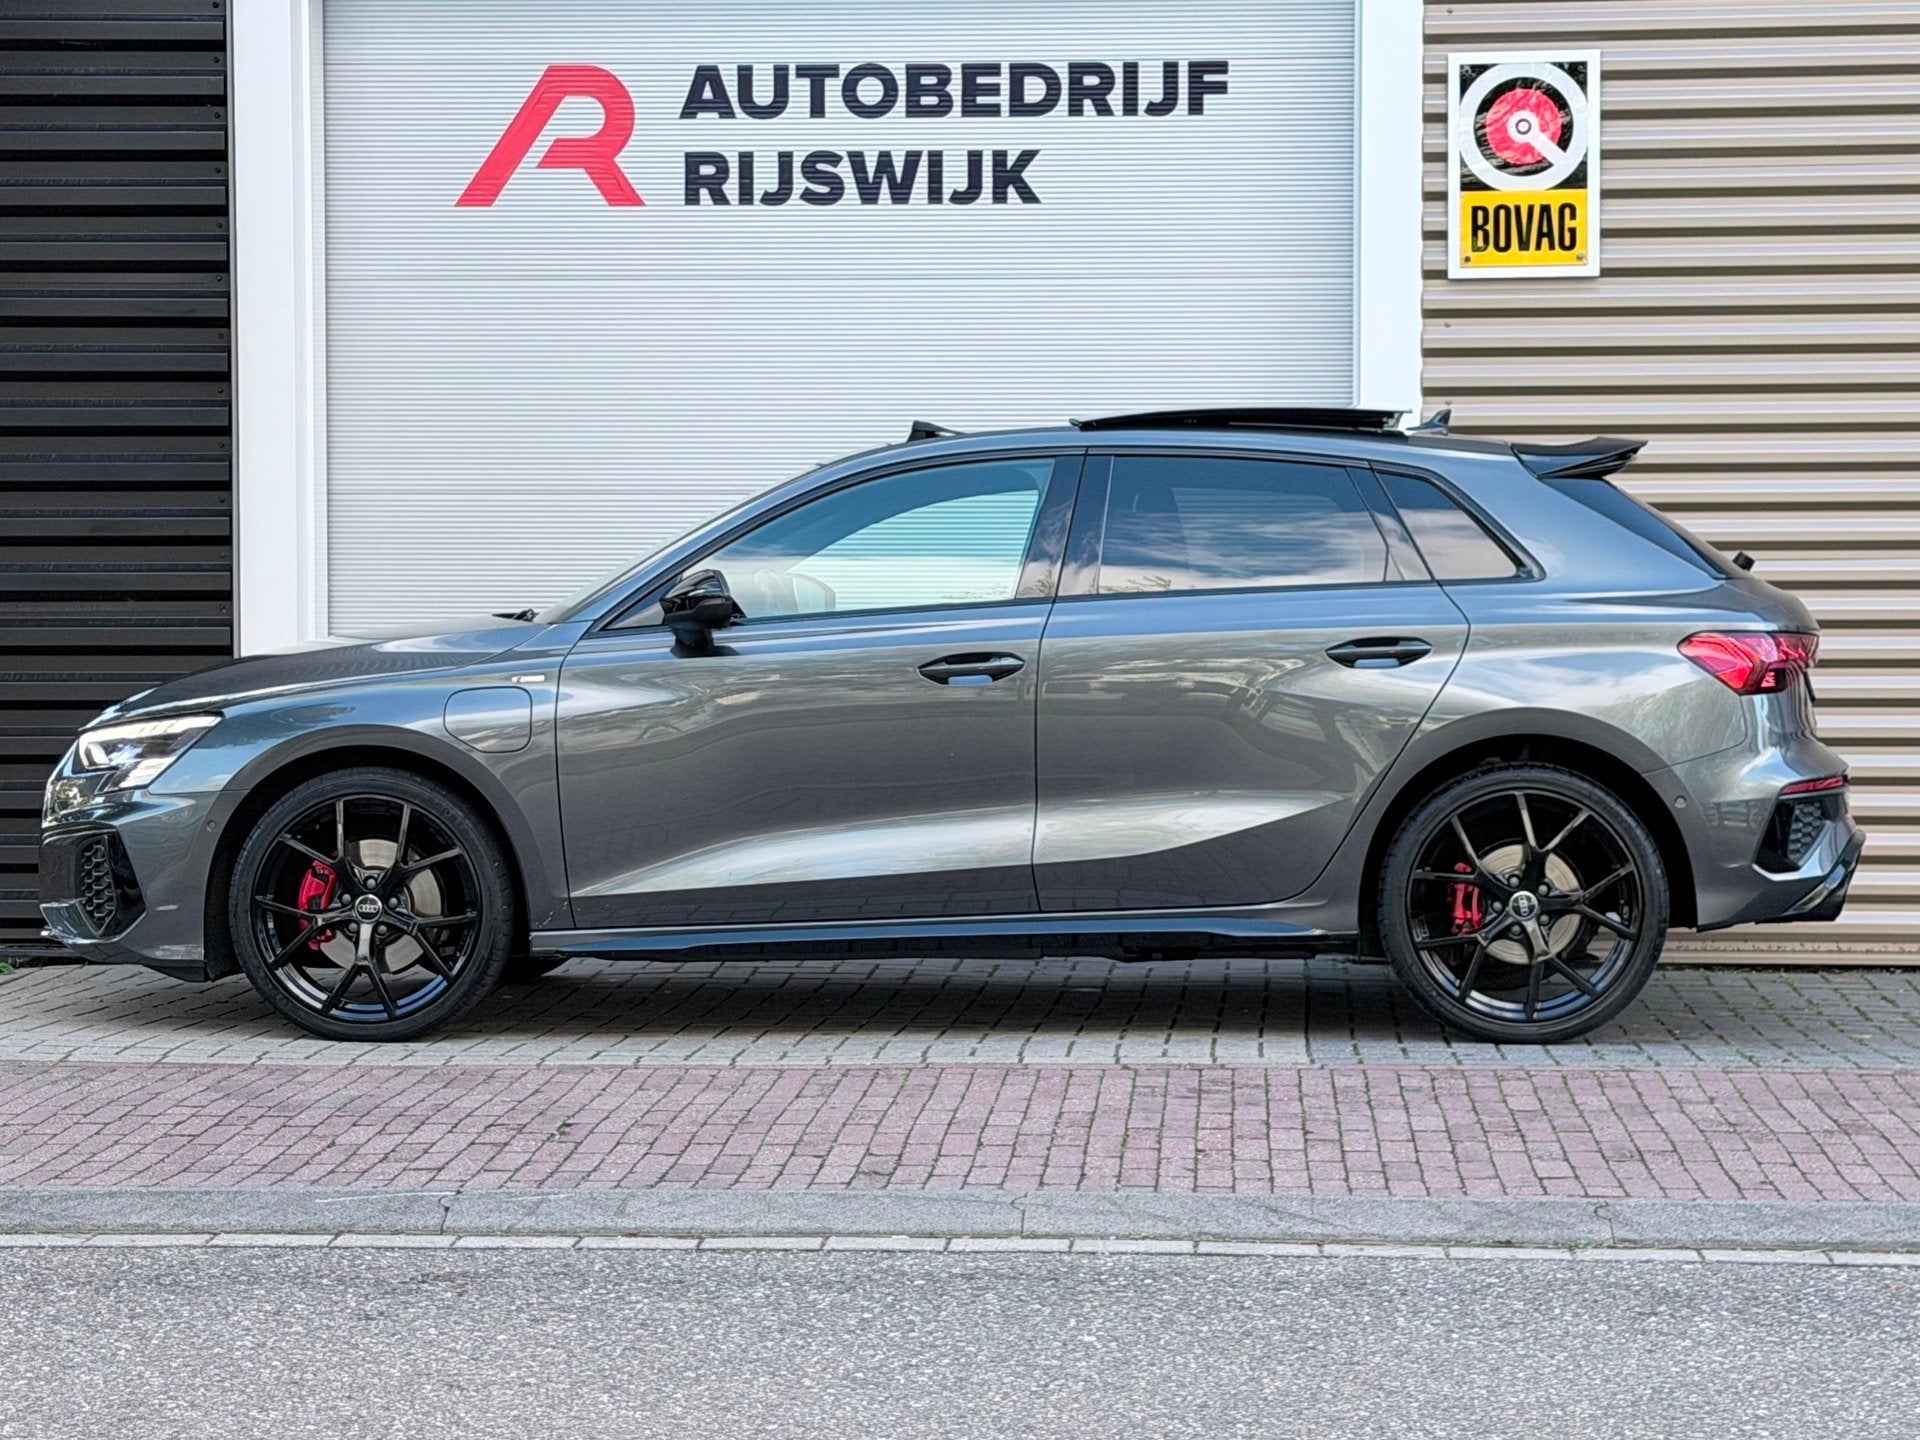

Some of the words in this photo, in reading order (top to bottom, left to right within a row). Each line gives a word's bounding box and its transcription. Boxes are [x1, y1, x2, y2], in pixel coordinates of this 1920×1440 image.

[680, 61, 1229, 120] AUTOBEDRIJF
[685, 150, 1041, 206] RIJSWIJK
[1471, 202, 1577, 252] BOVAG
